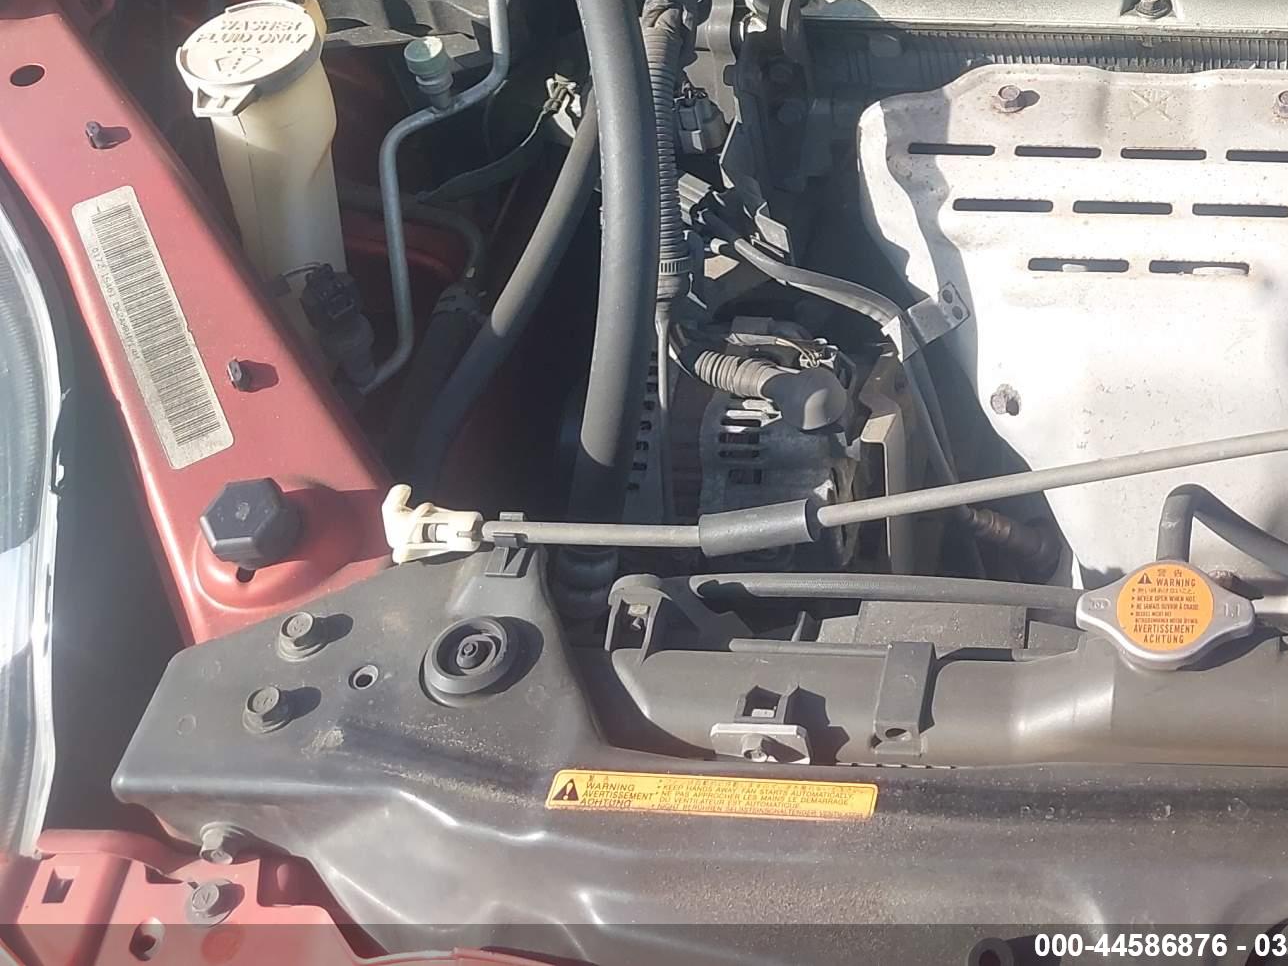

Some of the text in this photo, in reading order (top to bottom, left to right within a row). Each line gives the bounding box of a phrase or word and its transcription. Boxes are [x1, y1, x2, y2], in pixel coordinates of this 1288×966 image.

[221, 20, 303, 32] WASHER
[196, 33, 307, 45] FLUID ONLY
[1156, 578, 1197, 587] WARNING
[1133, 624, 1195, 634] AVERTISSEMENT
[1143, 634, 1185, 644] ACHTUNG
[585, 782, 636, 792] WARNING
[759, 787, 788, 796] STARTS
[581, 790, 653, 800] AVERTISSEMENT
